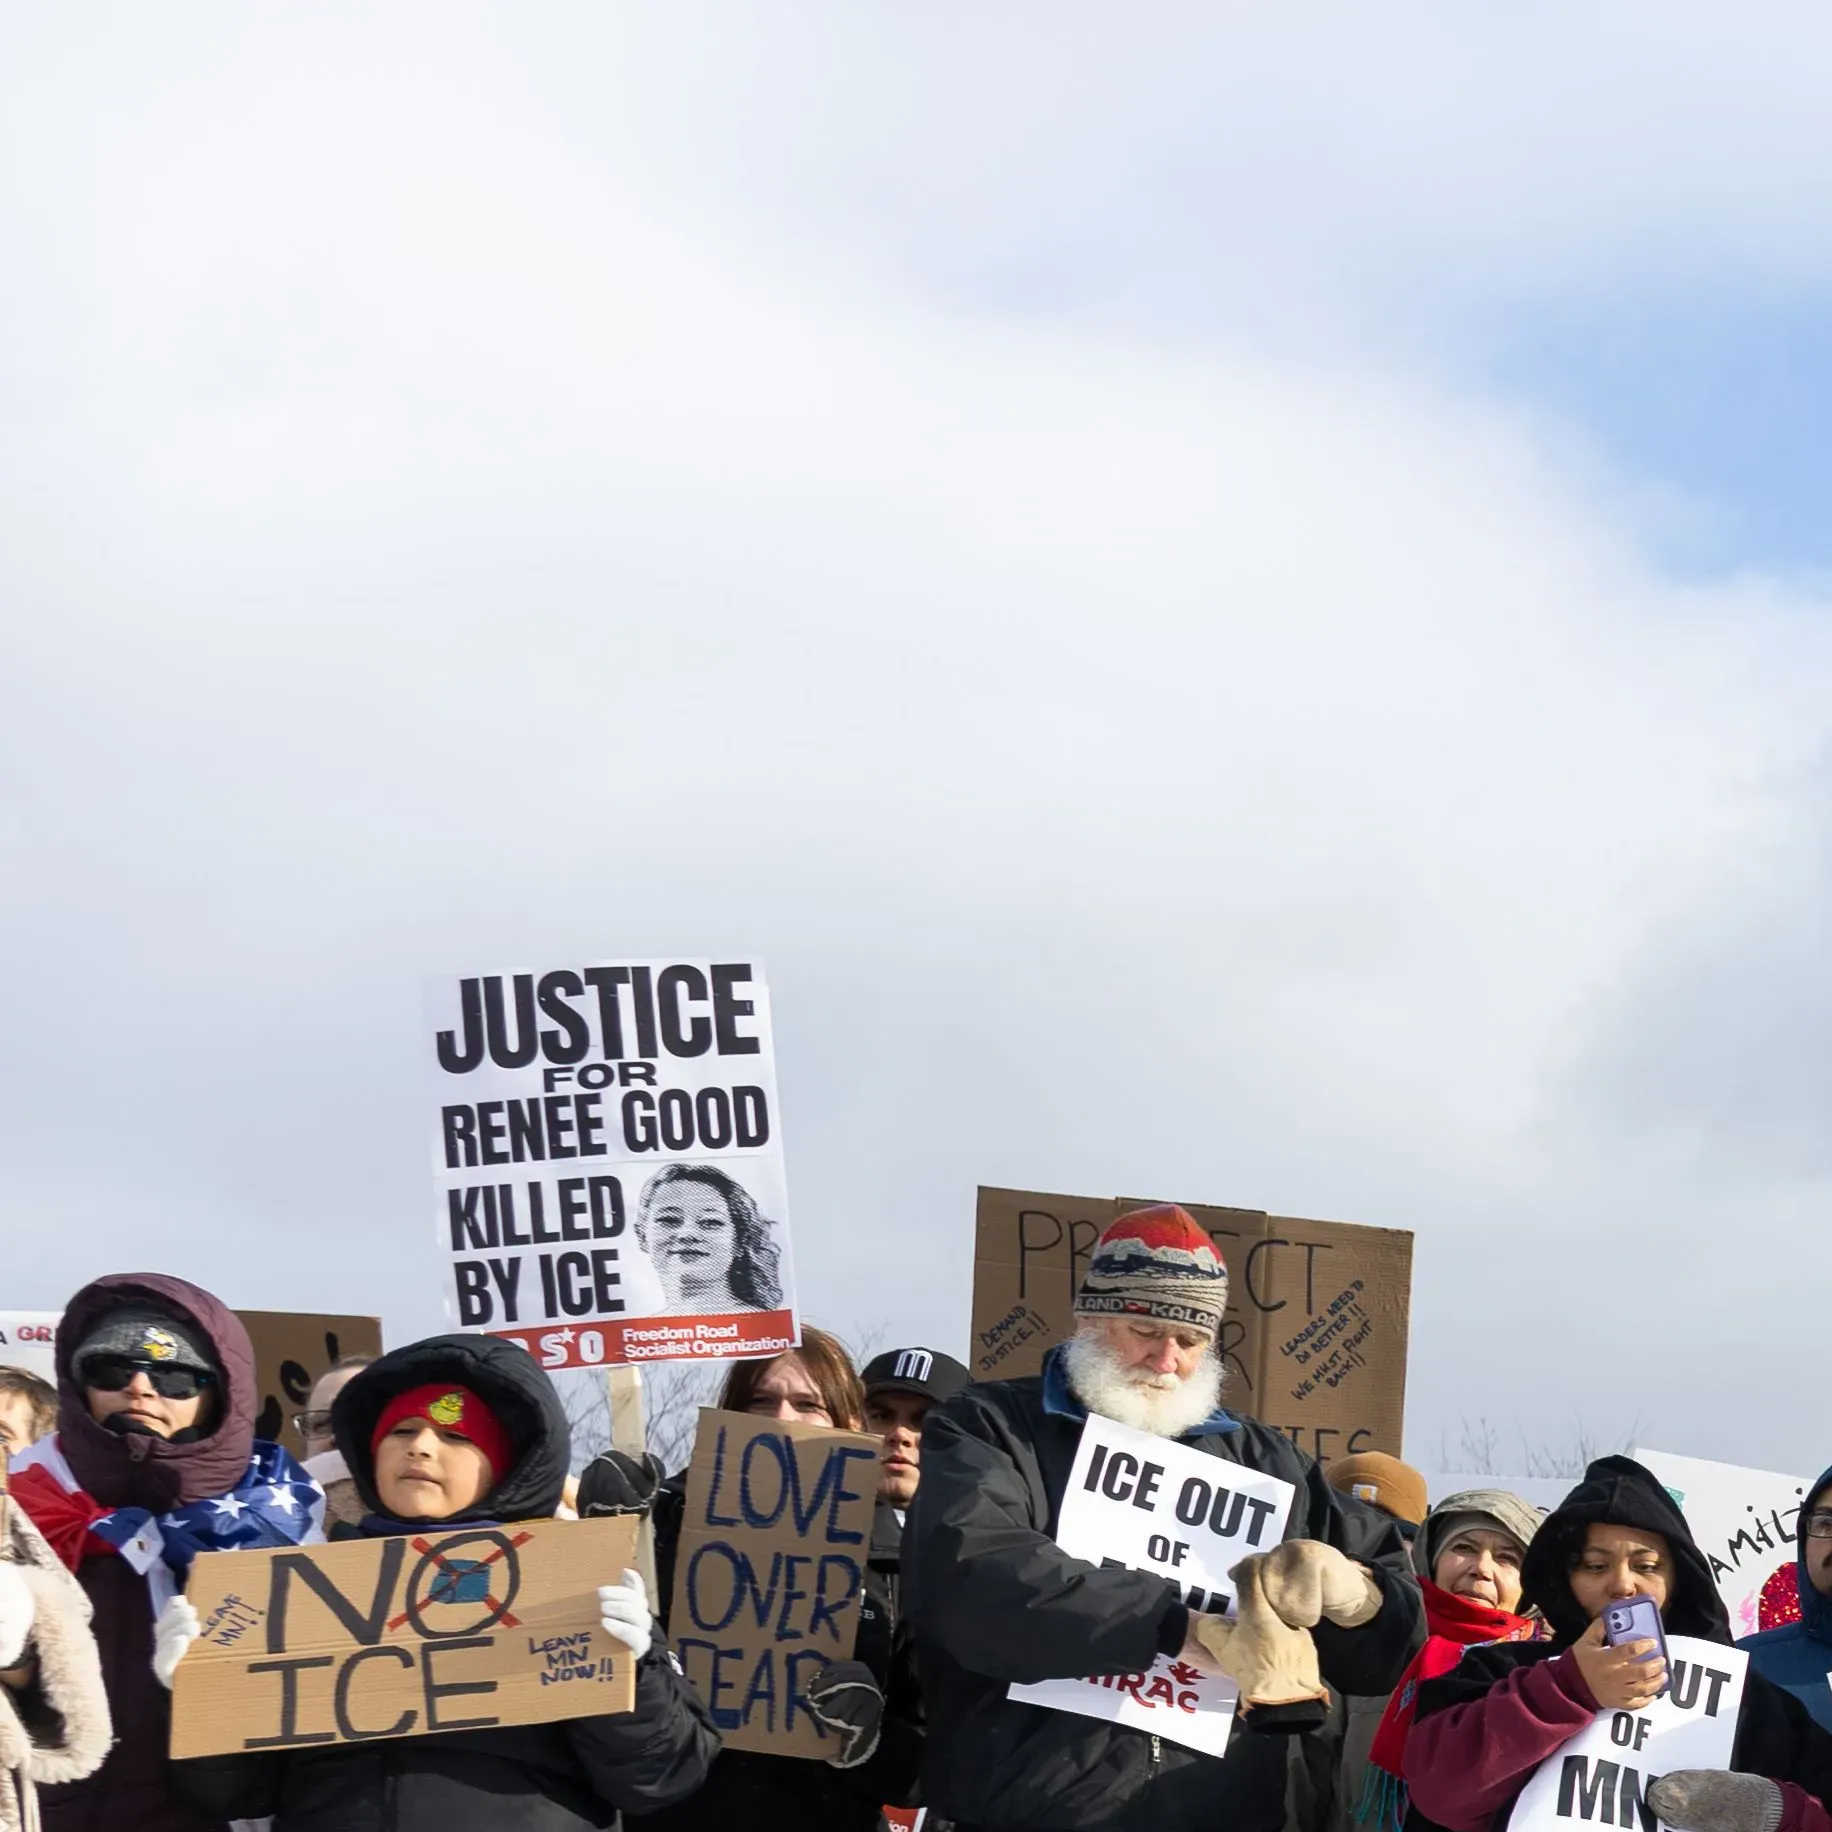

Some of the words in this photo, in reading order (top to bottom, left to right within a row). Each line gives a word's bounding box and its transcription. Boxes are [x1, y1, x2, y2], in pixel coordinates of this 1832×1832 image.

[436, 963, 760, 1074] JUSTICE
[543, 1061, 658, 1092] FOR
[441, 1093, 607, 1169] RENEE
[622, 1085, 769, 1153] GOOD
[447, 1175, 625, 1251] KILLED
[453, 1256, 521, 1326] BY
[539, 1248, 625, 1318] ICE
[622, 1327, 693, 1343] Freedom
[696, 1324, 738, 1339] Road
[624, 1343, 690, 1360] Socialist
[692, 1336, 790, 1356] Organization
[1279, 1316, 1327, 1356] LEADERS
[1290, 1380, 1314, 1400] WE
[705, 1425, 876, 1545] LOVE
[1083, 1444, 1165, 1512] ICE
[1175, 1477, 1276, 1547] OUT
[1147, 1534, 1190, 1567] OF
[266, 1530, 520, 1654] NO
[687, 1541, 862, 1643] OVER
[528, 1632, 592, 1655] LEAVE
[546, 1649, 589, 1669] MN
[244, 1636, 499, 1749] ICE
[1670, 1659, 1732, 1718] UT
[1611, 1712, 1652, 1751] OF
